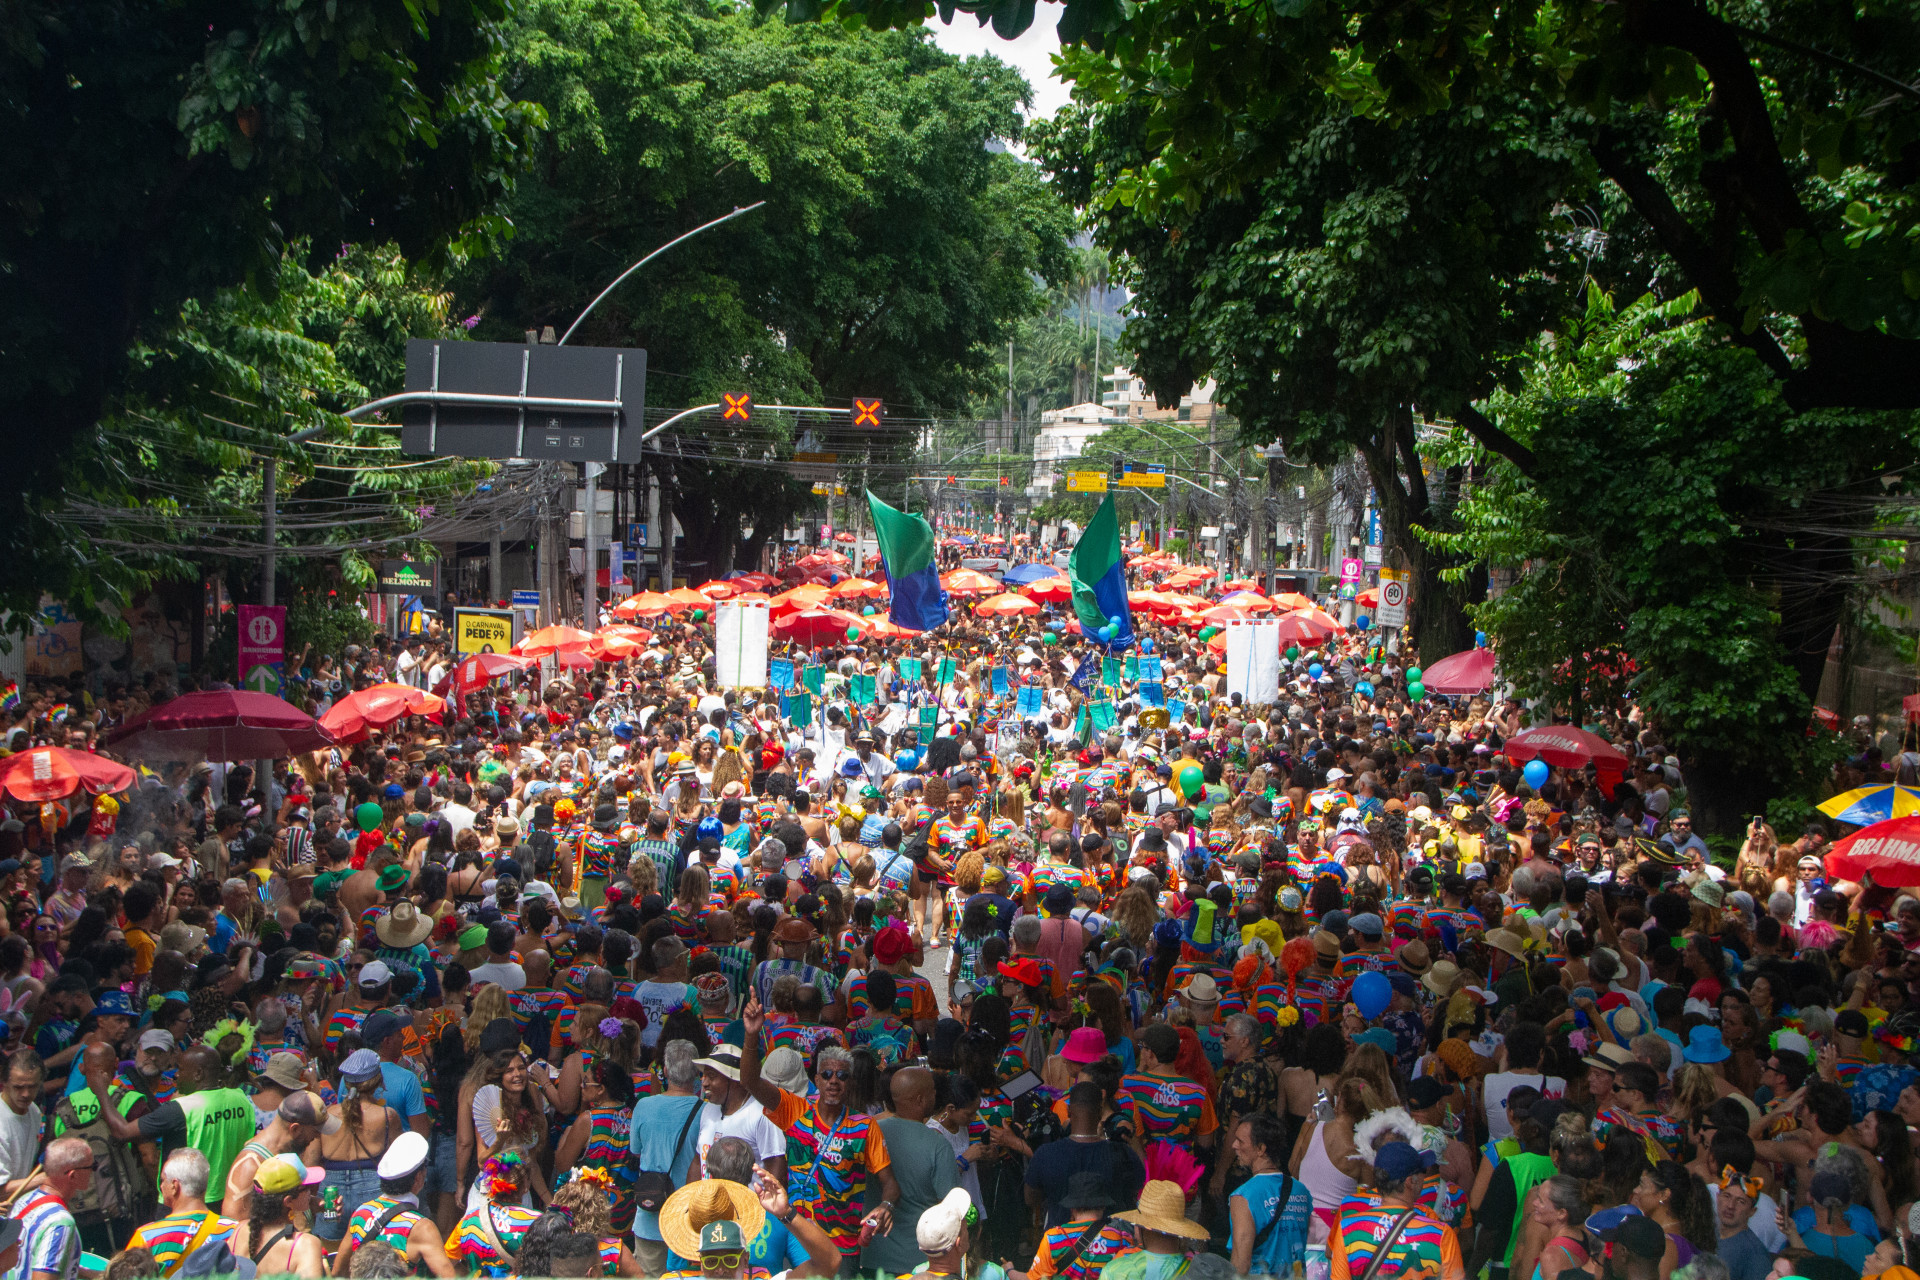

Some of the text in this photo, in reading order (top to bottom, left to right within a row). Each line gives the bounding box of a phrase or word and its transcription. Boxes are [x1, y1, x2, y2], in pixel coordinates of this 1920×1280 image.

[382, 577, 432, 587] BELMONTE
[1388, 588, 1399, 598] 60
[472, 621, 505, 629] CARNAVAL
[466, 628, 505, 640] PEDE 99
[1523, 734, 1580, 753] BRAHMA
[799, 1026, 814, 1038] 40
[1158, 1083, 1175, 1095] 40
[1152, 1092, 1181, 1106] ANOS
[204, 1107, 245, 1127] APOIO
[711, 1230, 727, 1243] SL
